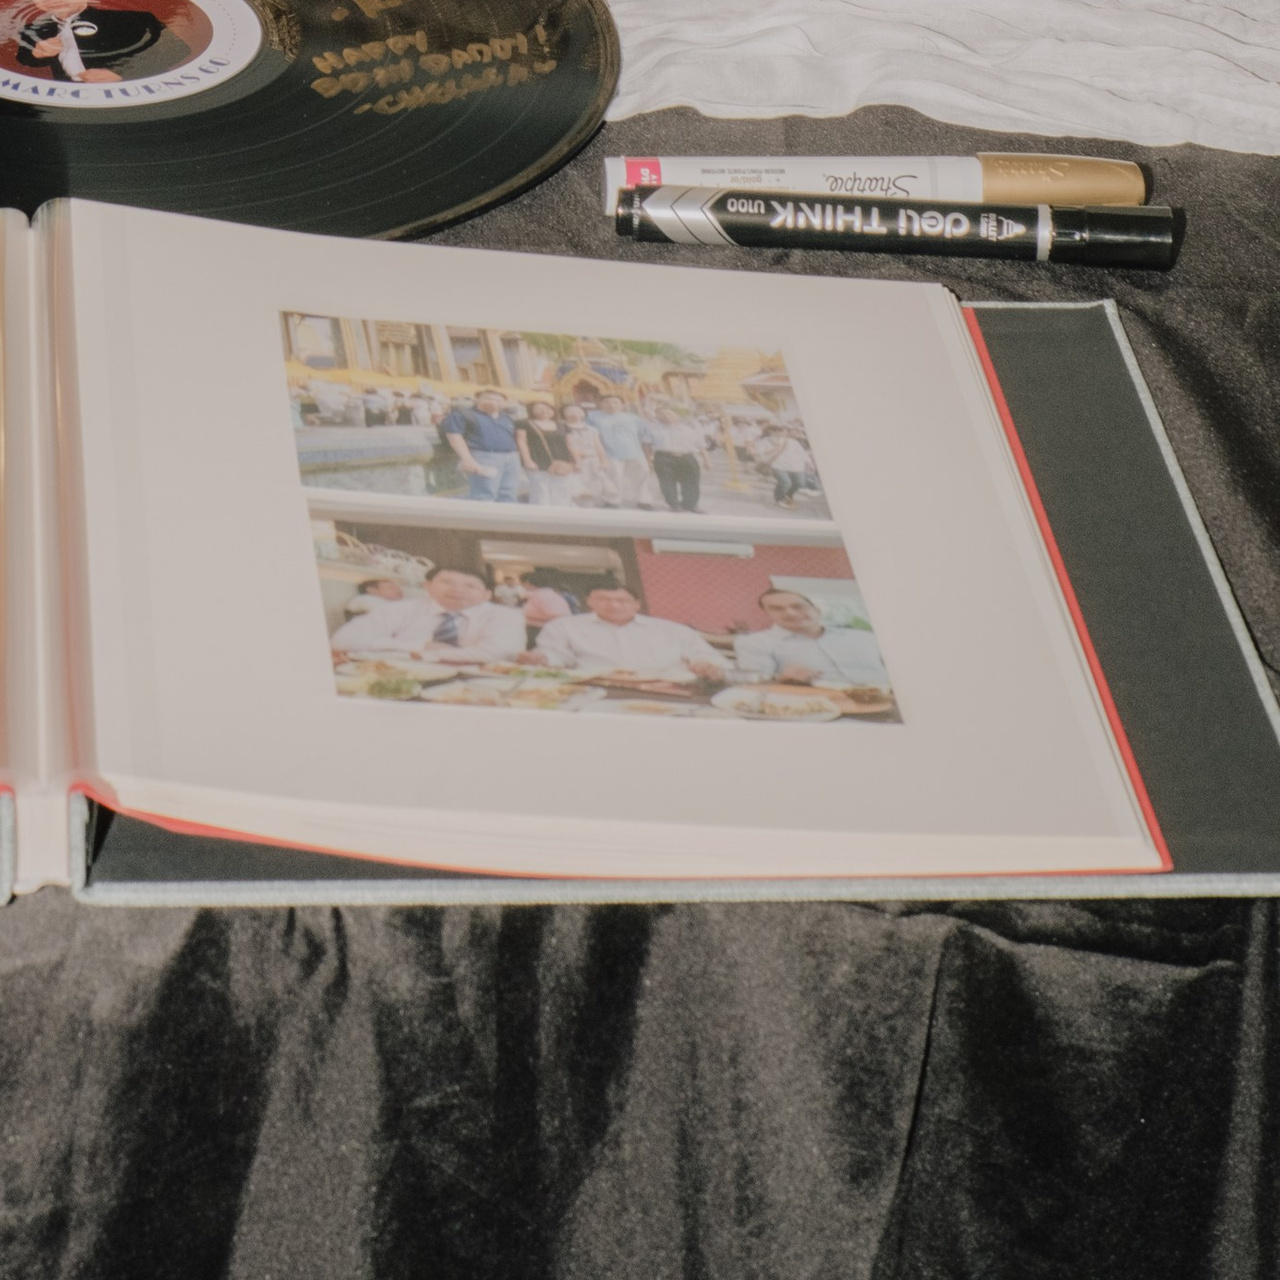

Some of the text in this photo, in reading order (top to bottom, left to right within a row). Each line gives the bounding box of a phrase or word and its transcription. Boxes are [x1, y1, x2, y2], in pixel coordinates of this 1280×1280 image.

[100, 74, 202, 100] TURNS
[198, 55, 231, 74] 60
[822, 173, 918, 197] Sharpie
[726, 197, 971, 239] deli THINK U100
